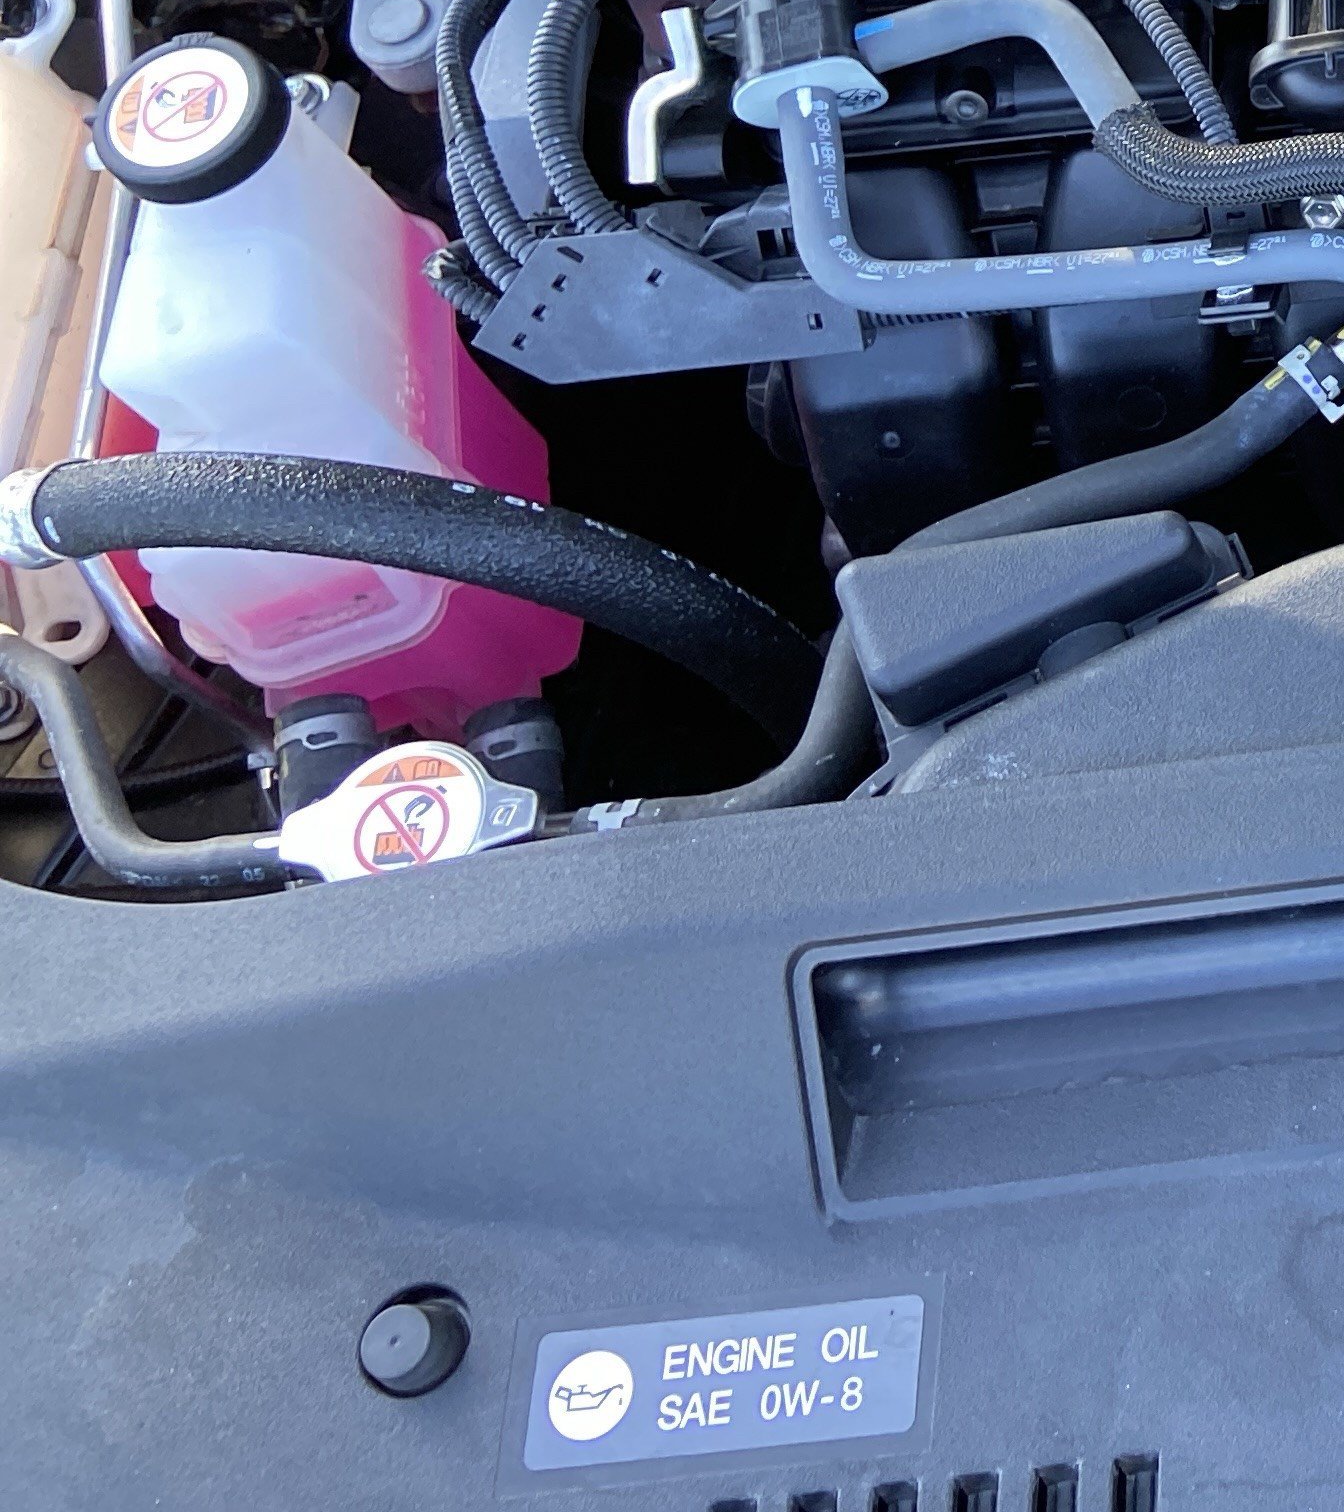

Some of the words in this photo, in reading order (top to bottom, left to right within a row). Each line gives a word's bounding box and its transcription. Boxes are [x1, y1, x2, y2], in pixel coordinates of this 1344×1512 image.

[662, 1333, 797, 1380] ENGINE
[821, 1325, 879, 1363] OIL
[657, 1389, 733, 1432] SAE
[760, 1376, 863, 1421] 0W-8
